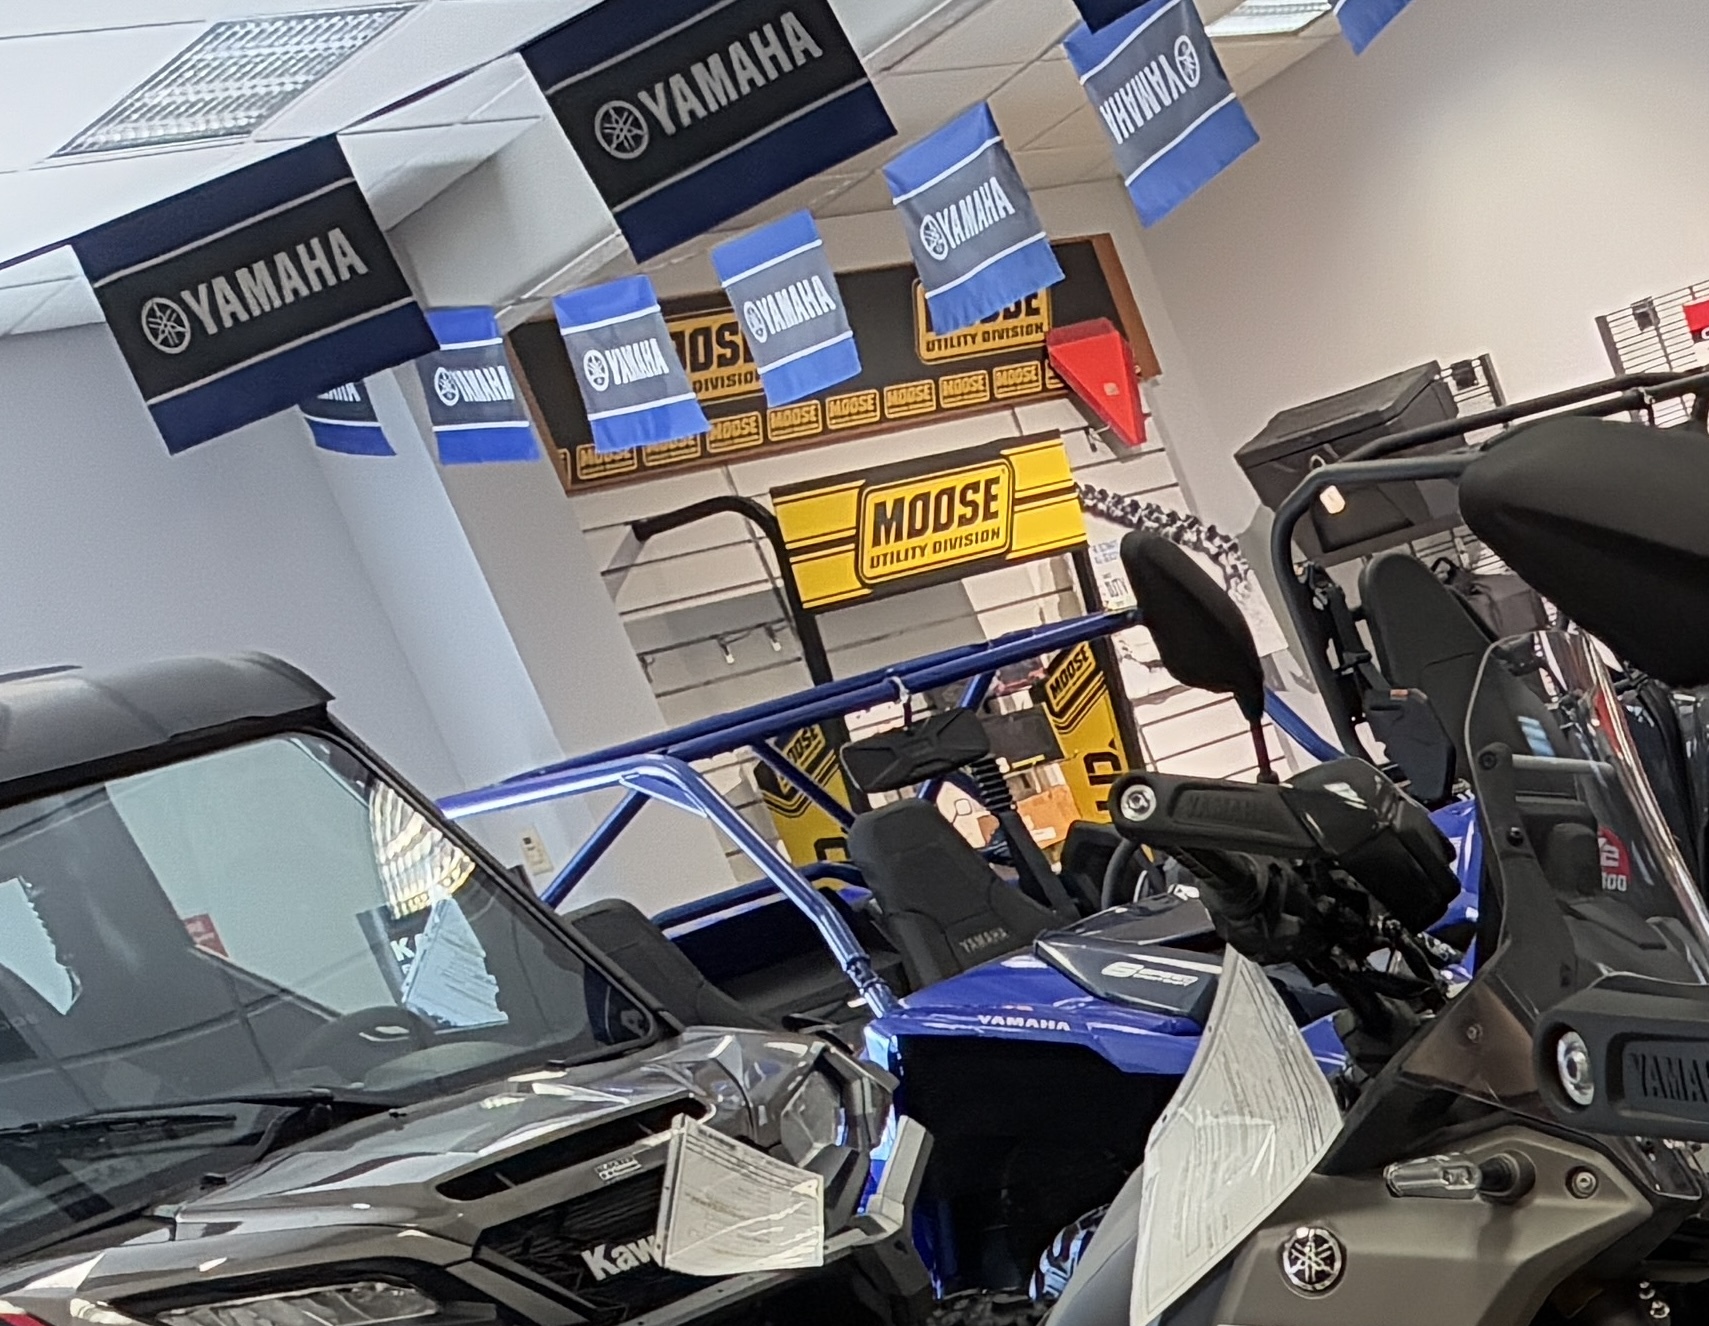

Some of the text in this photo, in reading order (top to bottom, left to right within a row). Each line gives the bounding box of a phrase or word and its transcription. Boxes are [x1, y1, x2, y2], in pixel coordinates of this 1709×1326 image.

[641, 10, 823, 137] YAMAHA
[944, 176, 1015, 251] YAMAHA
[181, 226, 368, 337] YAMAHA
[760, 275, 836, 335] YAMAHA
[926, 322, 1044, 353] UTILITY DIVISION
[605, 338, 669, 385] YAMAHA
[771, 408, 818, 427] MOOSE
[829, 393, 876, 418] MOOSE
[872, 478, 1001, 547] MOOSE
[869, 528, 1001, 571] UTILITY DIVISION
[977, 1014, 1071, 1031] YAMAHA
